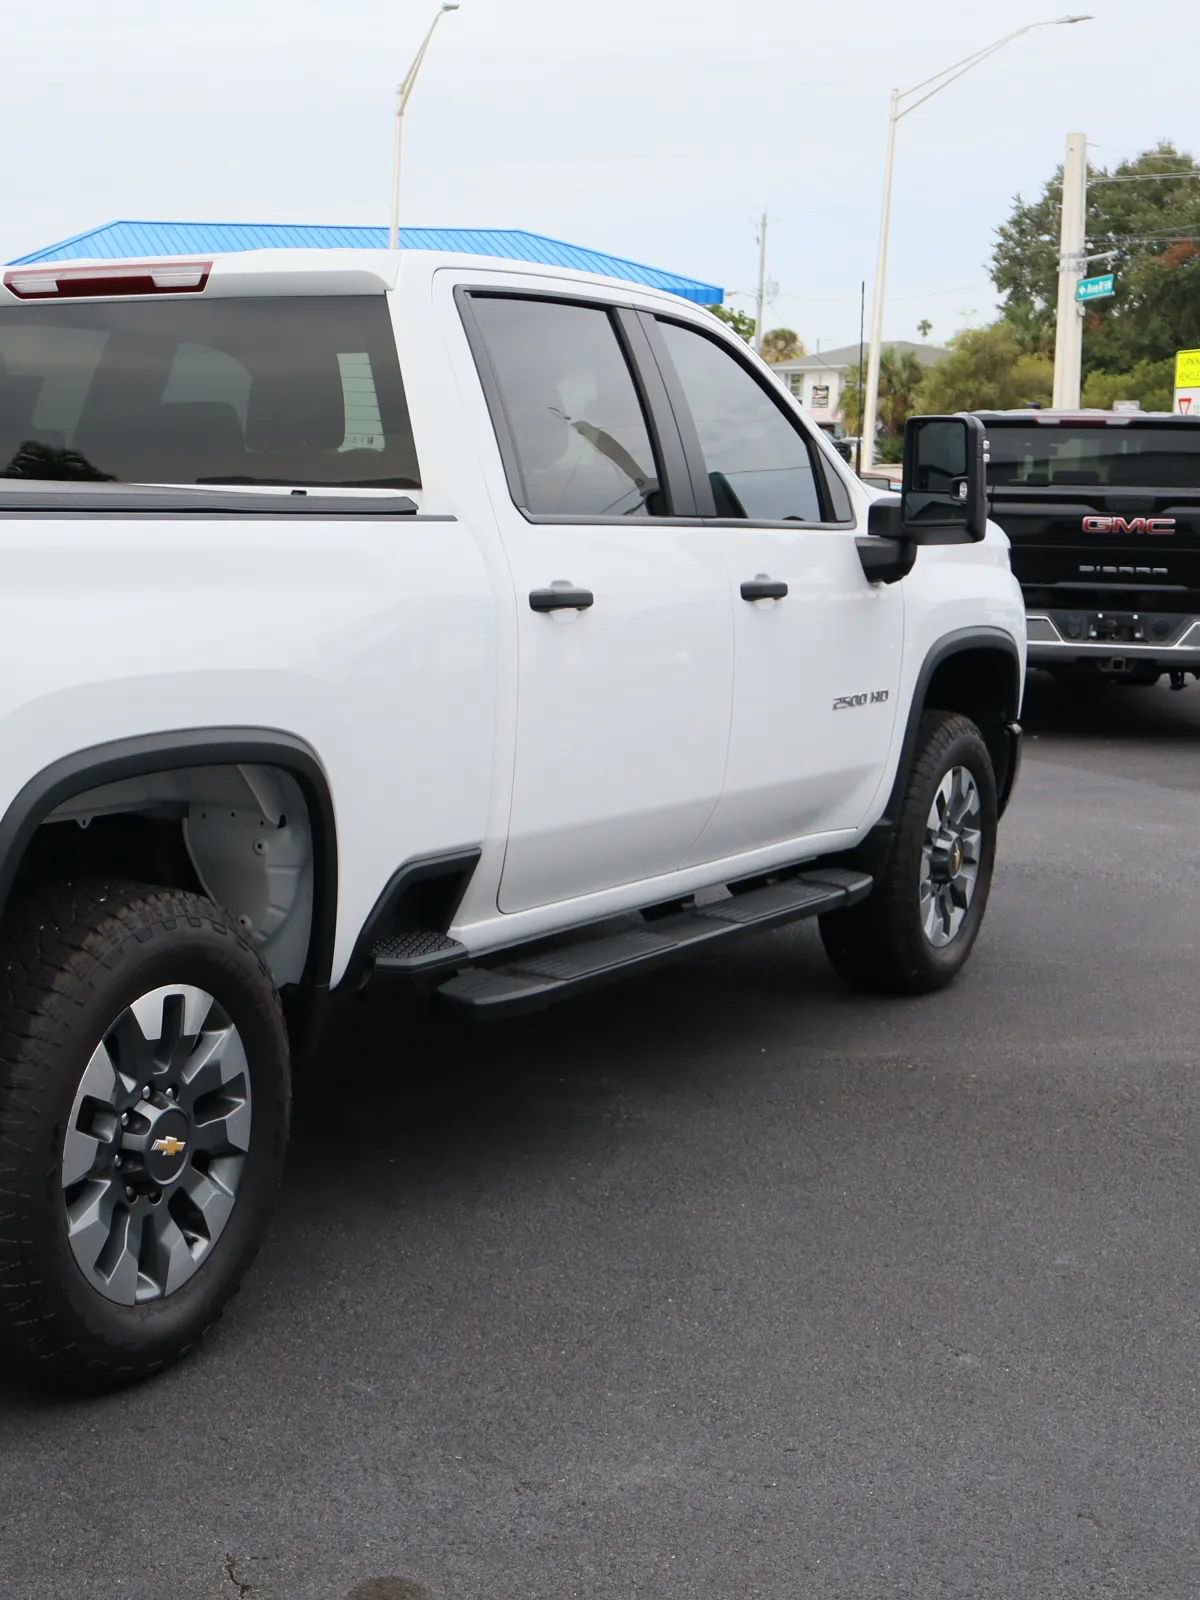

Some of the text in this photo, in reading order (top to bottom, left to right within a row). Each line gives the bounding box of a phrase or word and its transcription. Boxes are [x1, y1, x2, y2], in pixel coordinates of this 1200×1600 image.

[1082, 516, 1176, 535] GMC
[832, 690, 889, 711] 2500 HD
